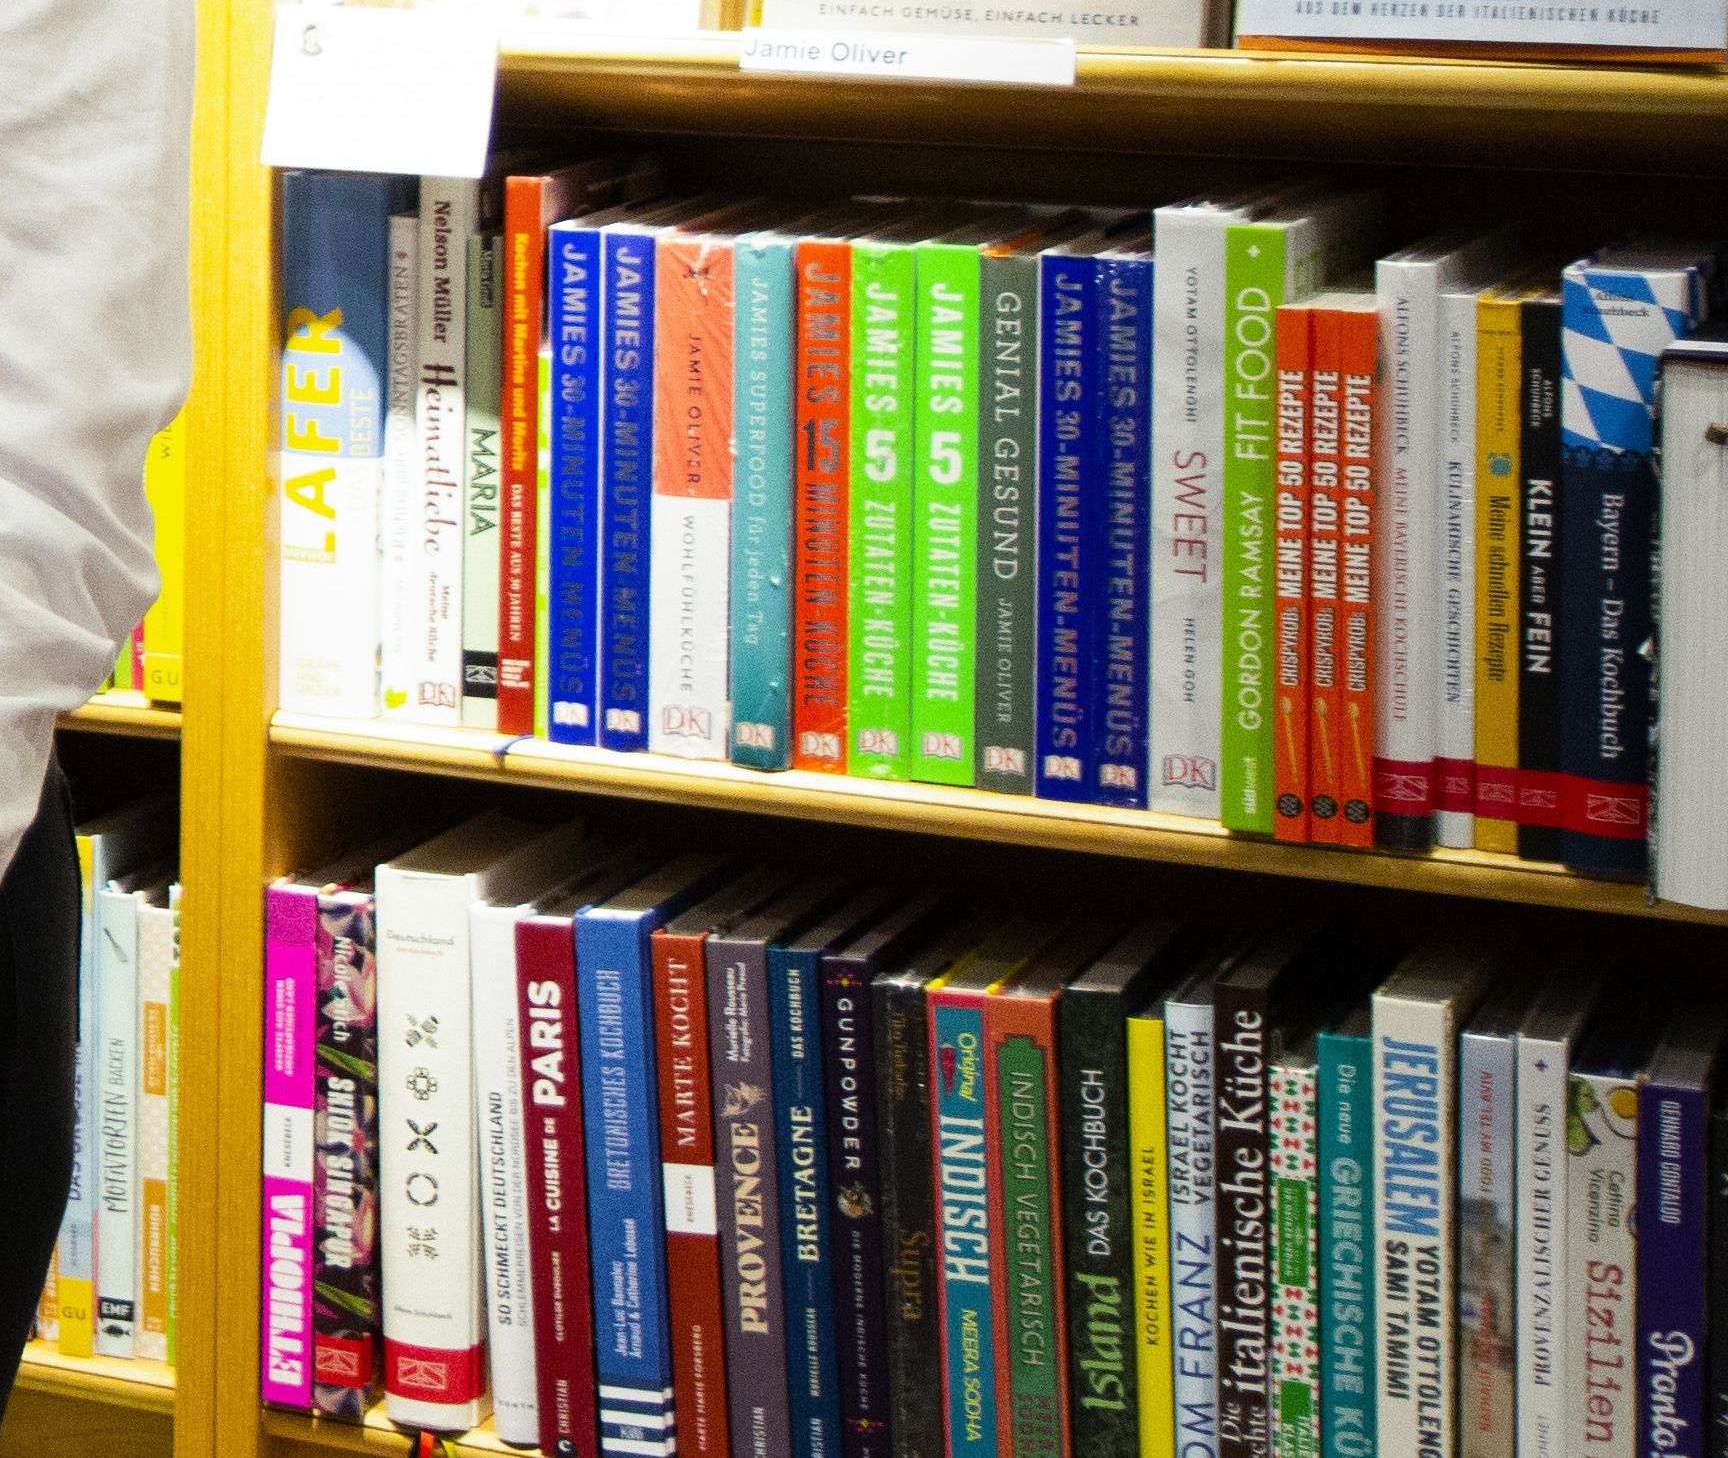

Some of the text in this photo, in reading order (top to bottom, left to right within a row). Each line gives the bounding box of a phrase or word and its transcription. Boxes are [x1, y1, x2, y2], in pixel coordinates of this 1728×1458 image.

[745, 38, 908, 66] Jamie Oliver
[818, 2, 895, 19] EINFACH
[984, 9, 1064, 26] EINFACH
[1069, 12, 1141, 28] LECKER
[1294, 0, 1662, 25] AUS DEM HERZEN DER ITALIENISCHEN KÜCHE
[433, 199, 452, 345] Nelson Müller
[284, 306, 343, 564] LAFER
[420, 362, 458, 558] Heimatliebe
[991, 291, 1022, 580] GENIAL GESUND
[1234, 285, 1273, 462] FIT FOOD
[470, 429, 498, 537] MARIA
[862, 282, 897, 698] JAMIES 5 ZUTATEN-KÜCHE
[1050, 273, 1082, 750] JAMIES 30-MINUTEN-MENÜS
[1105, 278, 1137, 757] JAMIES 30-MINUTEN-MENÜS
[1172, 449, 1208, 584] SWEET
[1277, 369, 1305, 598] MEINE TOP 50 REZEPTE
[1311, 369, 1340, 599] MEINE TOP 50 REZEPTE
[1344, 372, 1372, 603] MEINE TOP 50 REZEPTE
[149, 668, 179, 686] GU
[1237, 493, 1263, 731] GORDON RAMSAY
[1594, 493, 1624, 759] Bayern Das Kochbuch
[100, 1036, 130, 1214] MOTIVTORTEN BACKEN
[529, 978, 566, 1107] PARIS
[668, 957, 696, 1149] MARTE KOCHT
[837, 996, 862, 1170] GUNPOWDER
[1169, 1028, 1191, 1206] ISRAEL KOCHT
[1190, 1030, 1212, 1207] VEGETARISCH
[790, 1105, 821, 1263] BRETAGNE
[940, 1115, 990, 1285] INDISCH
[1008, 1071, 1043, 1368] INDISCH VEGETARISCH
[1218, 1007, 1268, 1405] italienische Küche
[1380, 1035, 1443, 1238] JERUSALEM
[61, 1306, 86, 1322] GU
[99, 1301, 132, 1317] EMF
[728, 1120, 769, 1335] PROVENCE
[1074, 1069, 1126, 1412] Island DAS KOCHBUCH
[1384, 1239, 1411, 1401] SAMI TAMIMI
[1584, 1258, 1626, 1443] Sizilien
